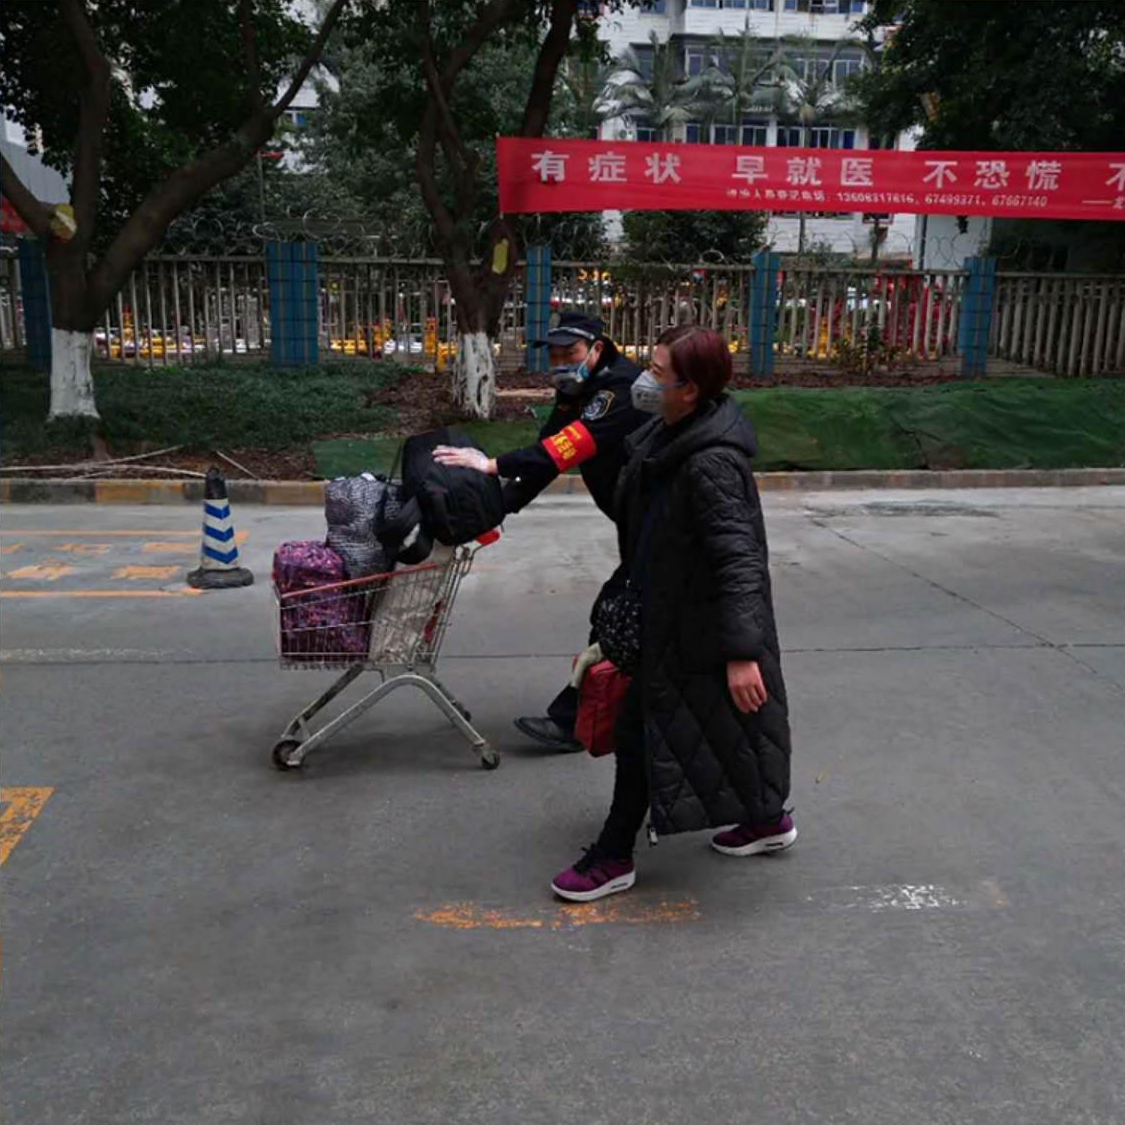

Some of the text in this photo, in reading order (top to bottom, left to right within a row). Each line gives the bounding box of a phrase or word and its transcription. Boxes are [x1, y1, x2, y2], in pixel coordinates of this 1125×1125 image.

[531, 150, 681, 184] 有症状
[732, 155, 874, 187] 早就医
[922, 159, 1062, 191] 不恐慌
